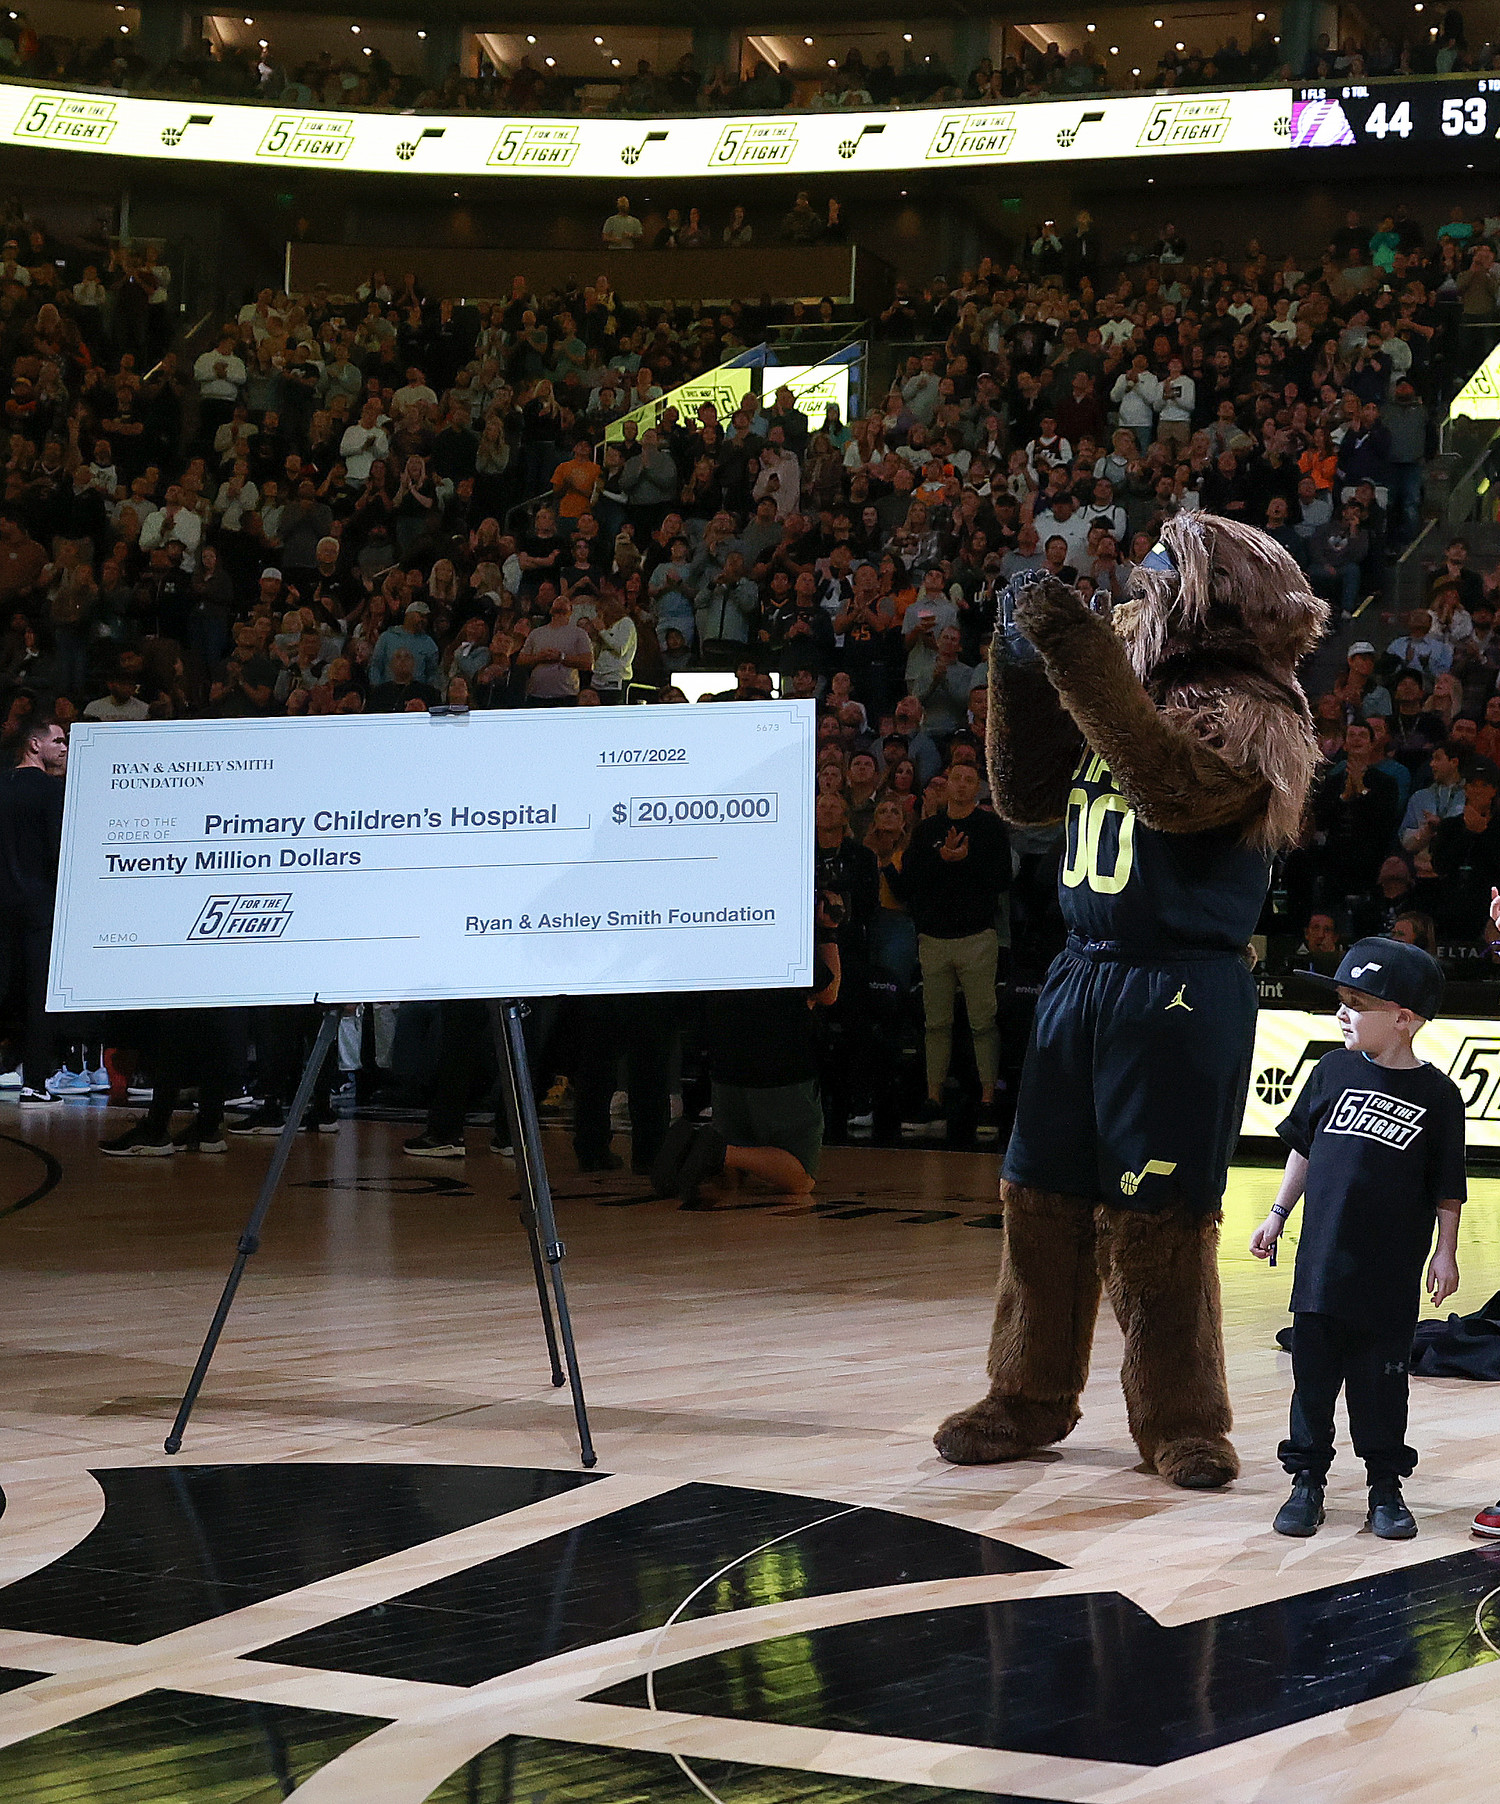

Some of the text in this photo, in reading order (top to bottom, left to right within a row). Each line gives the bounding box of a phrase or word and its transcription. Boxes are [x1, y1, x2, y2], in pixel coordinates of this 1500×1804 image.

[1308, 89, 1326, 99] FLS
[1342, 87, 1351, 98] 6
[1478, 80, 1487, 92] 5
[26, 102, 53, 132] 5
[1146, 109, 1170, 142] 5
[1365, 102, 1413, 138] 44
[1442, 97, 1486, 136] 53
[53, 119, 109, 141] FIGHT
[268, 120, 292, 152] 5
[935, 120, 959, 153] 5
[1174, 120, 1222, 142] FIGHT
[295, 137, 346, 157] FIGHT
[496, 130, 521, 162] 5
[522, 141, 571, 163] FIGHT
[718, 130, 742, 162] 5
[743, 141, 790, 161] FIGHT
[960, 133, 1009, 155] FIGHT
[111, 758, 274, 775] RYAN & ASHLEY SMITH
[598, 748, 687, 764] 11/07/2022
[111, 776, 205, 790] FOUNDATION
[108, 816, 178, 829] PAY TO THE
[204, 813, 306, 836] Primary
[450, 804, 558, 830] Hospital
[611, 797, 771, 826] $ 20,000,000
[107, 829, 170, 841] ORDER OF
[105, 847, 362, 875] Twenty Million Dollars
[239, 898, 283, 910] FOR THE
[198, 900, 230, 935] 5
[226, 916, 284, 934] FIGHT
[465, 906, 776, 934] Ryan & Ashley Smith Foundation
[98, 932, 138, 943] MEMO
[1437, 947, 1480, 958] ELTA
[1459, 1049, 1500, 1109] 5
[1336, 1096, 1364, 1127] 5
[1370, 1098, 1416, 1120] FOR THE
[1354, 1113, 1412, 1143] FIGHT
